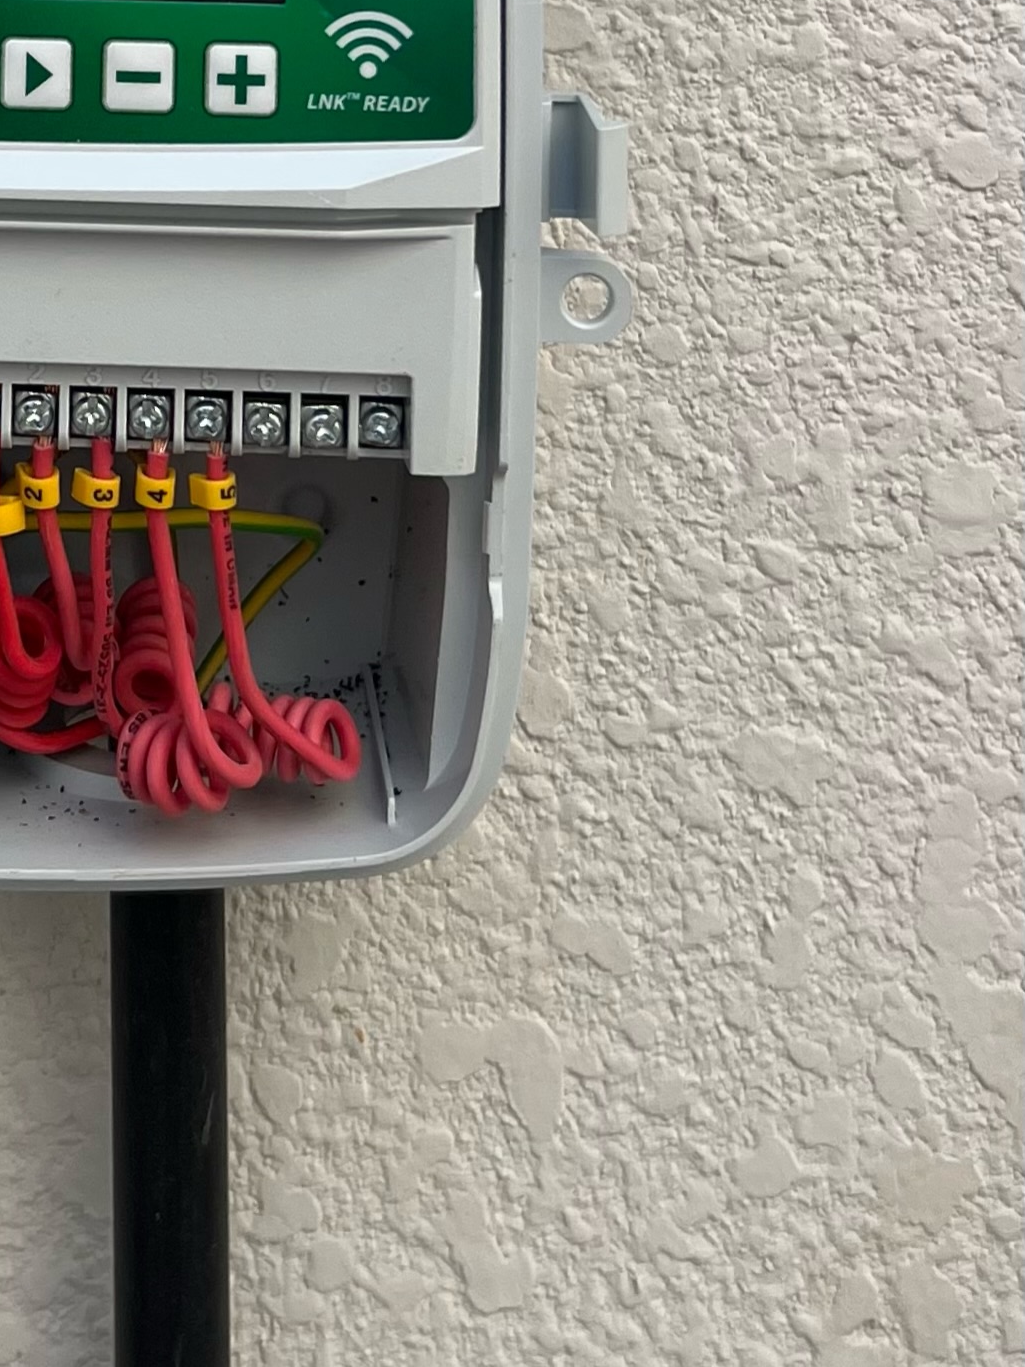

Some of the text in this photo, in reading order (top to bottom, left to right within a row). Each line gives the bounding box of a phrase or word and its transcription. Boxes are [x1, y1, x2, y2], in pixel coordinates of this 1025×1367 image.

[363, 95, 430, 113] READY
[142, 367, 161, 387] 4
[24, 486, 43, 502] 2
[93, 488, 113, 503] 3
[147, 489, 168, 504] 4
[220, 485, 236, 500] 5
